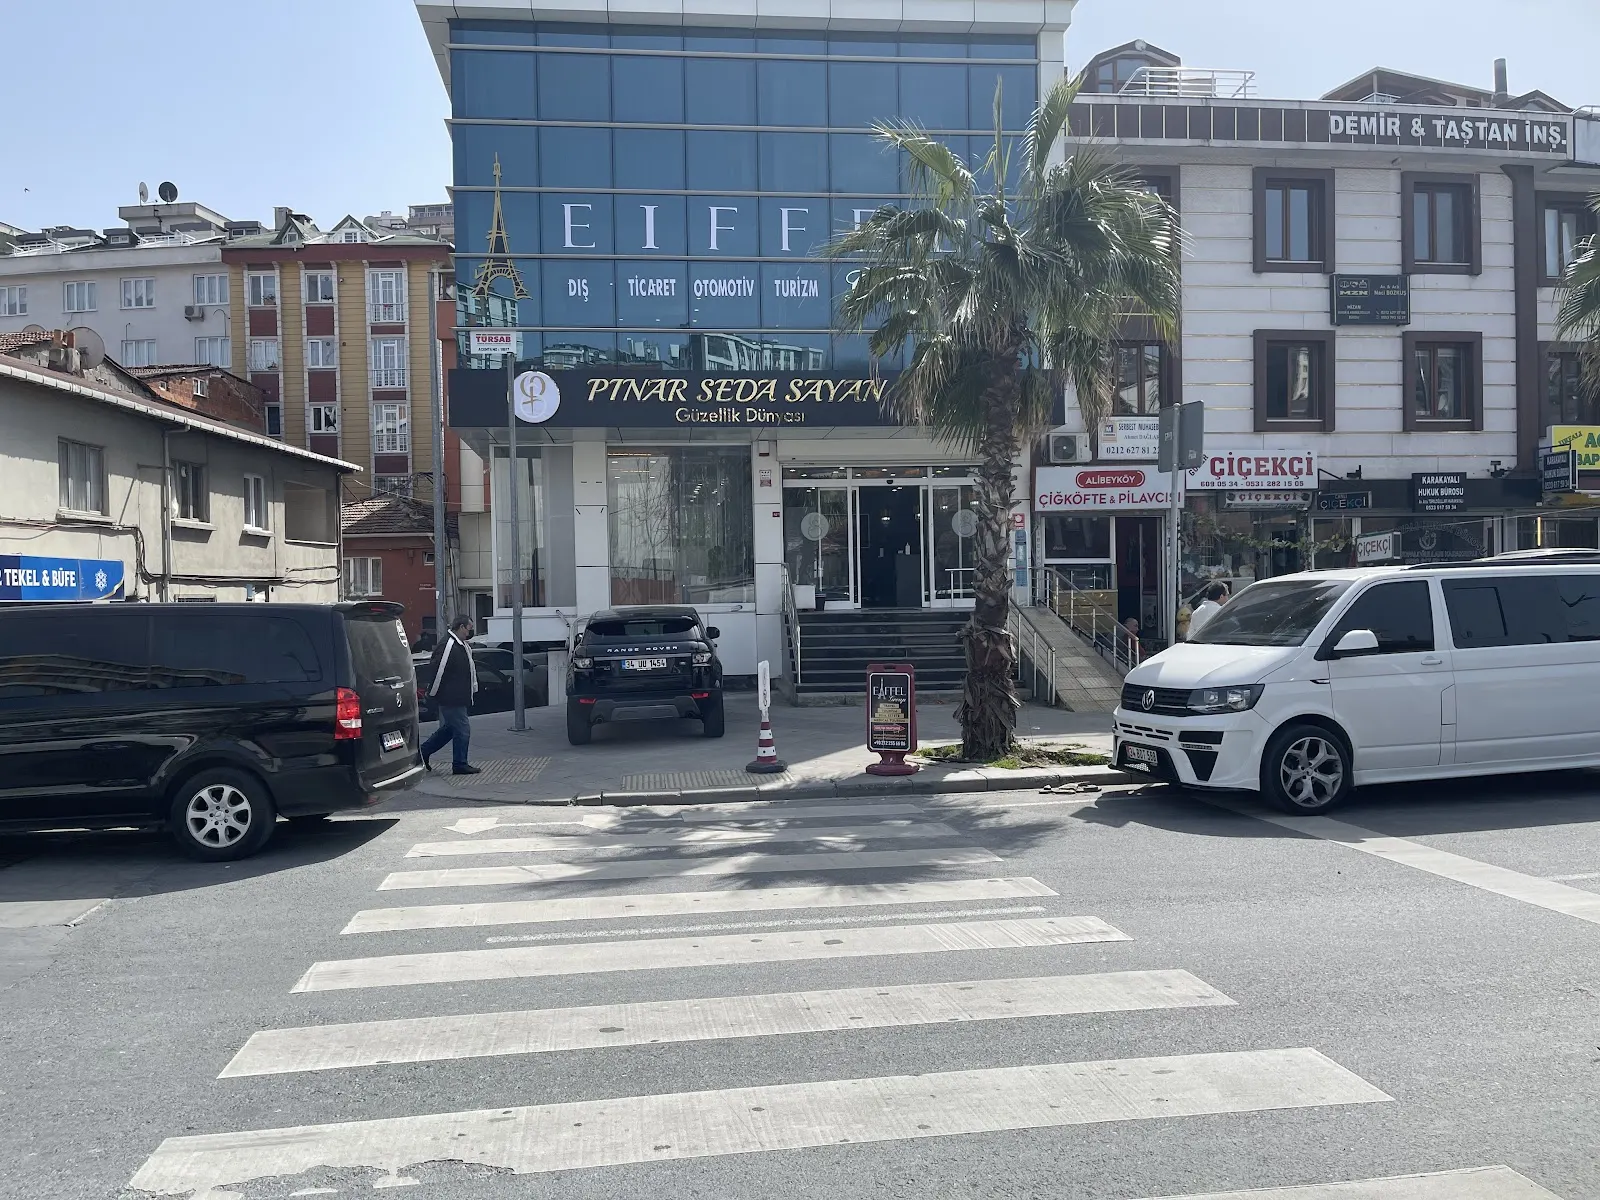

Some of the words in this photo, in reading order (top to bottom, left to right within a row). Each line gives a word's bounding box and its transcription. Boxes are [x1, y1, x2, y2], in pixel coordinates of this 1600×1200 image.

[1330, 112, 1401, 136] DEMİR
[1410, 118, 1426, 138] &
[1432, 119, 1517, 145] TAŞTAN
[1525, 120, 1567, 149] İNŞ.
[568, 278, 590, 303] DIŞ
[628, 277, 677, 298] TİCARET
[693, 277, 755, 299] OTOMOTİV
[774, 277, 819, 298] TURİZM
[475, 335, 512, 343] TÜRSAB
[587, 378, 689, 404] PINAR
[695, 378, 778, 404] SEDA
[785, 379, 888, 404] SAYAN
[675, 407, 742, 423] Güzellik
[745, 407, 806, 426] Dünyası
[1584, 432, 1600, 448] A
[1106, 446, 1124, 454] 0212
[1126, 446, 1139, 454] 627
[1141, 446, 1150, 454] 81
[1209, 451, 1314, 480] ÇİÇEKÇİ
[1085, 475, 1136, 485] ALİBEYKÖY
[1421, 476, 1460, 484] KARAKAYALI
[1039, 491, 1107, 508] ÇİĞKÖFTE
[1109, 495, 1116, 504] &
[1418, 488, 1440, 497] HUKUK
[1440, 486, 1464, 496] BÜROSU
[1357, 536, 1391, 557] ÇİÇEKÇİ
[3, 568, 40, 587] TEKEL
[42, 569, 50, 587] &
[52, 567, 77, 587] BÜFE
[625, 659, 635, 669] 34
[649, 658, 666, 667] 1454
